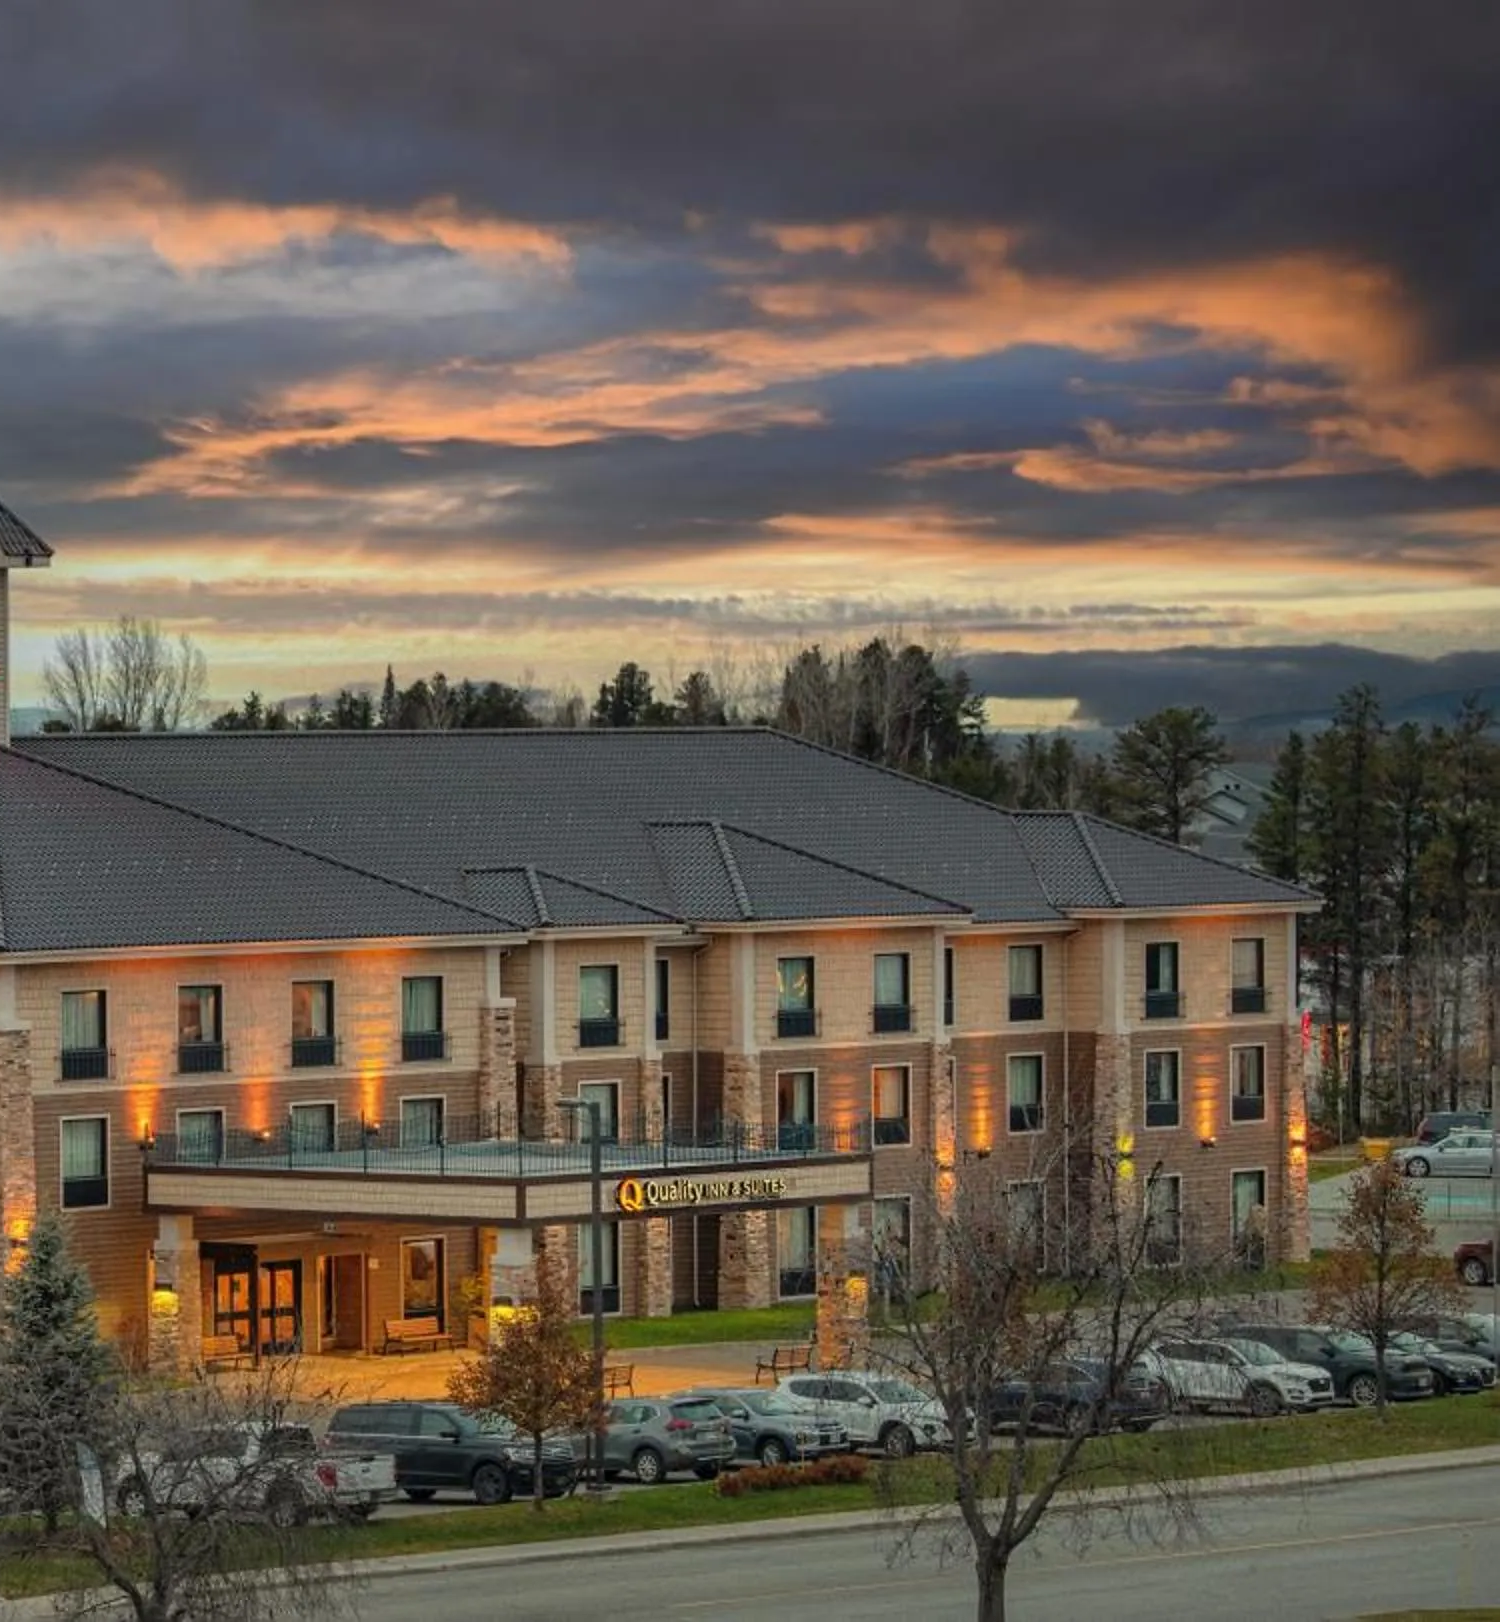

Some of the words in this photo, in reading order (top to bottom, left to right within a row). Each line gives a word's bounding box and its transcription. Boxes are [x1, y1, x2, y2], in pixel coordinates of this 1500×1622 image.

[619, 1179, 645, 1211] Q
[647, 1179, 702, 1205] Quality
[731, 1182, 741, 1195] &
